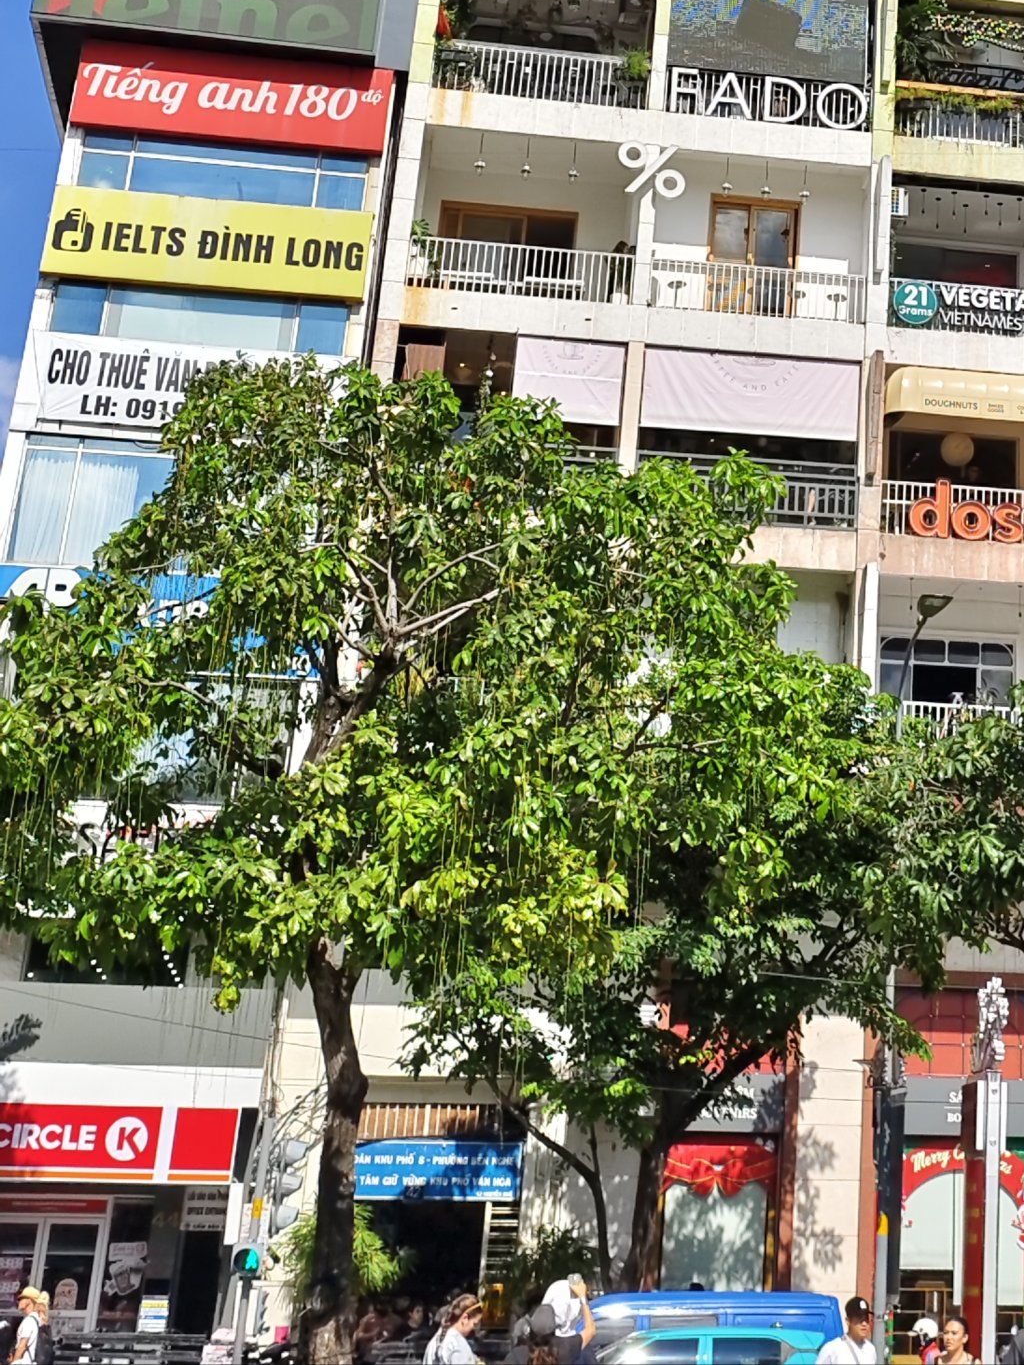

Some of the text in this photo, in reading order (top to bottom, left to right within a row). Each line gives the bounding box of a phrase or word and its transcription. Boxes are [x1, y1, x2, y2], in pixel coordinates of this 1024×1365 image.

[82, 62, 187, 116] Tiếng
[198, 80, 277, 116] anh
[284, 84, 358, 122] 180
[669, 67, 868, 130] FADO
[101, 221, 364, 272] IELTS ĐÌNH LONG
[904, 285, 927, 307] 21
[899, 305, 933, 318] Grams
[47, 348, 91, 387] CHO
[98, 348, 153, 390] THUÊ
[80, 395, 117, 419] LH:
[924, 398, 978, 411] DOUGHNUTS
[0, 1123, 97, 1151] CIRCLE
[910, 1150, 951, 1173] Merry
